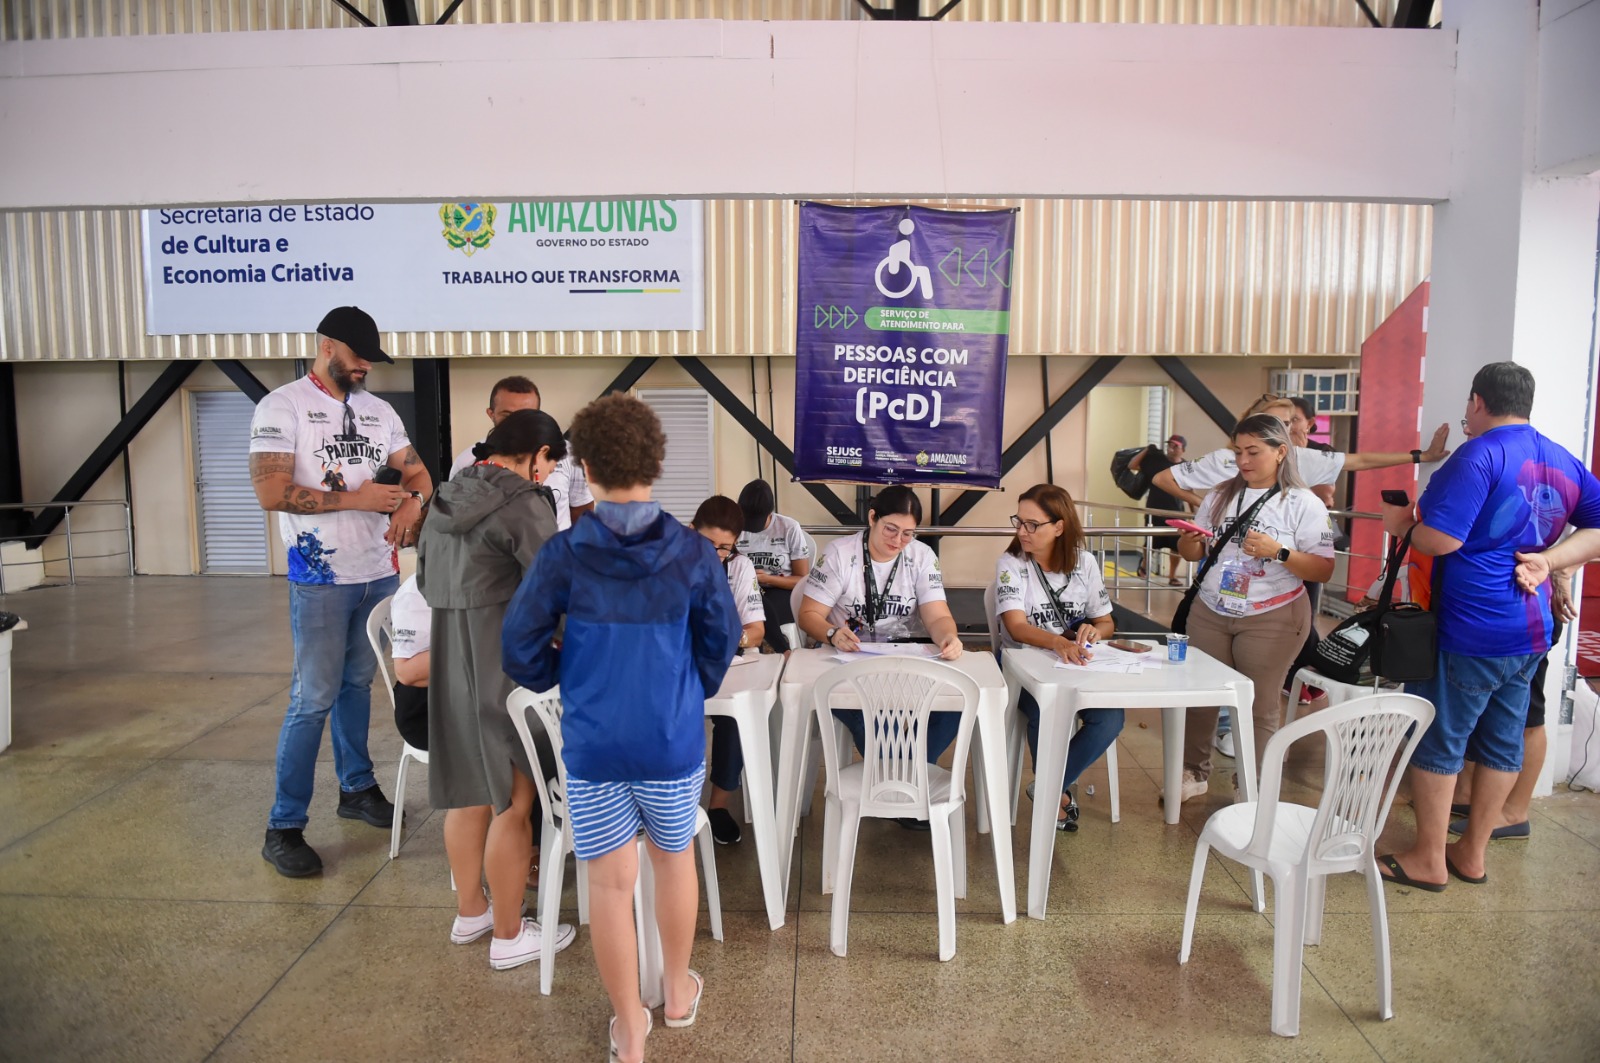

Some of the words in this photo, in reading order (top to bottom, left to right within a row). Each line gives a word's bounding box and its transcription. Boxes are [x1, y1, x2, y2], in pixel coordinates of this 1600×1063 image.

[160, 207, 262, 225] Secretaria
[269, 205, 297, 223] de
[303, 204, 375, 221] Estado
[507, 200, 678, 233] AMAZONAS
[161, 236, 189, 254] de
[194, 234, 270, 253] Cultura
[275, 238, 289, 252] e
[536, 238, 587, 247] GOVERNO
[590, 238, 606, 247] DO
[608, 238, 649, 247] ESTADO
[163, 264, 266, 284] Economia
[271, 263, 354, 282] Criativa
[442, 271, 528, 284] TRABALHO
[531, 270, 565, 284] QUE
[569, 269, 681, 283] TRANSFORMA
[880, 309, 917, 320] SERVIÇO
[918, 310, 930, 319] DE
[880, 320, 941, 330] ATENDIMENTO
[941, 322, 965, 331] PARA
[834, 344, 917, 364] PESSOAS
[920, 348, 968, 365] COM
[843, 365, 957, 387] DEFICIÊNCIA
[826, 446, 863, 457] SEJUSC
[930, 453, 967, 464] AMAZONAS
